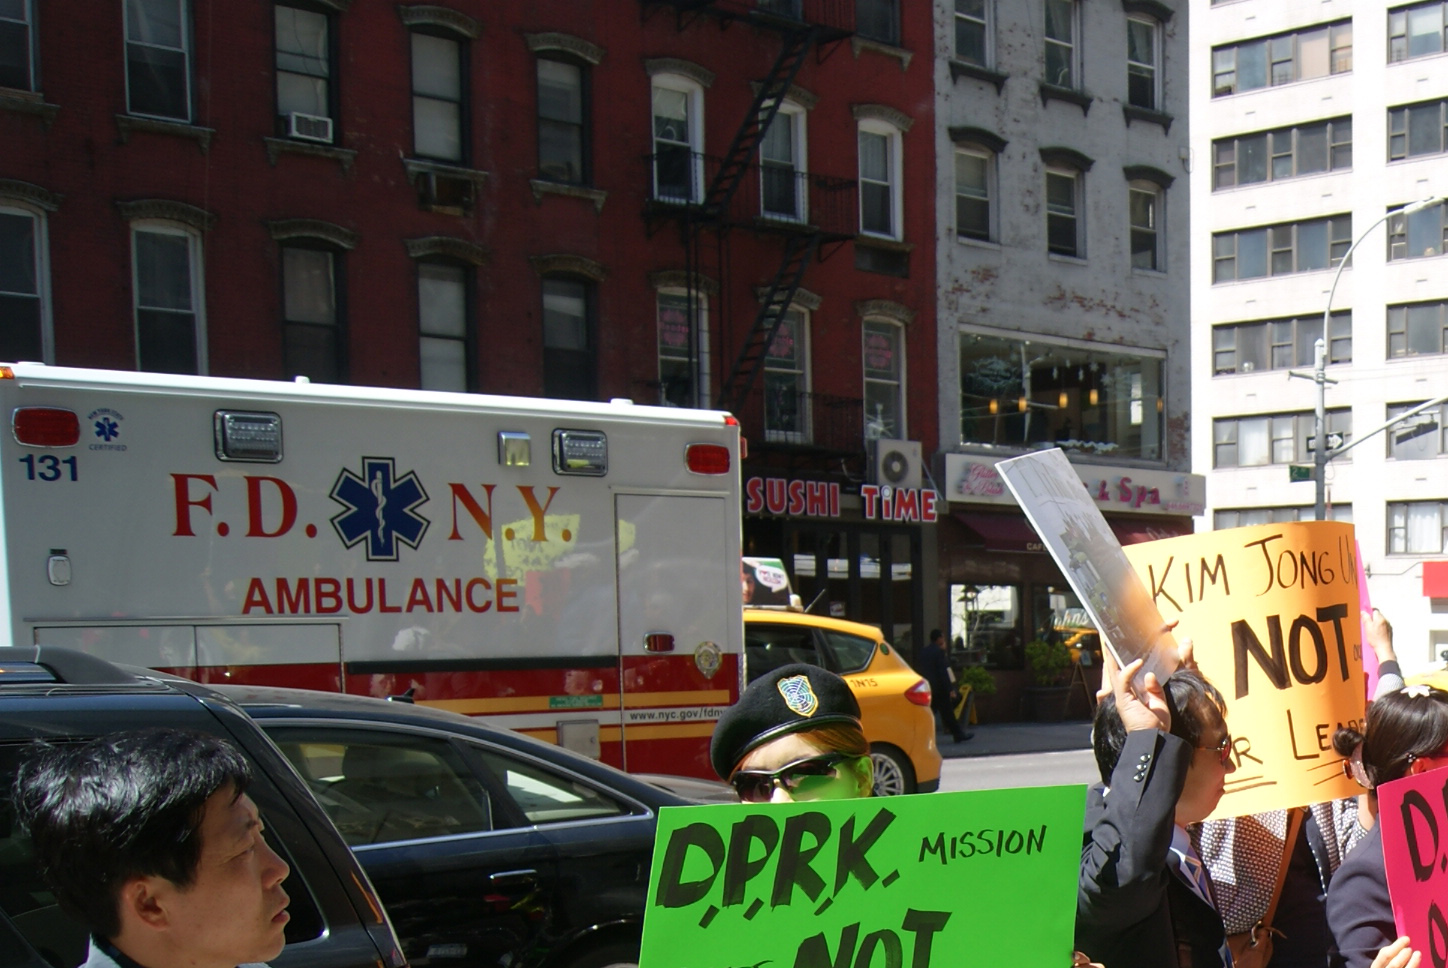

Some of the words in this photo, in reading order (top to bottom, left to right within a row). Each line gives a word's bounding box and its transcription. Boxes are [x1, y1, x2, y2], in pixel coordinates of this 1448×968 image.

[19, 454, 78, 482] 131
[1119, 477, 1160, 508] Spa
[171, 473, 318, 537] F.D.
[448, 483, 572, 541] N.Y.
[746, 476, 840, 518] SUSHI
[242, 578, 519, 614] AMBULANCE
[1148, 554, 1230, 612] KIM
[1244, 534, 1335, 597] JONG
[1230, 604, 1350, 700] NOT
[655, 807, 900, 928] D.P.R.K.
[918, 825, 1048, 865] MISSION
